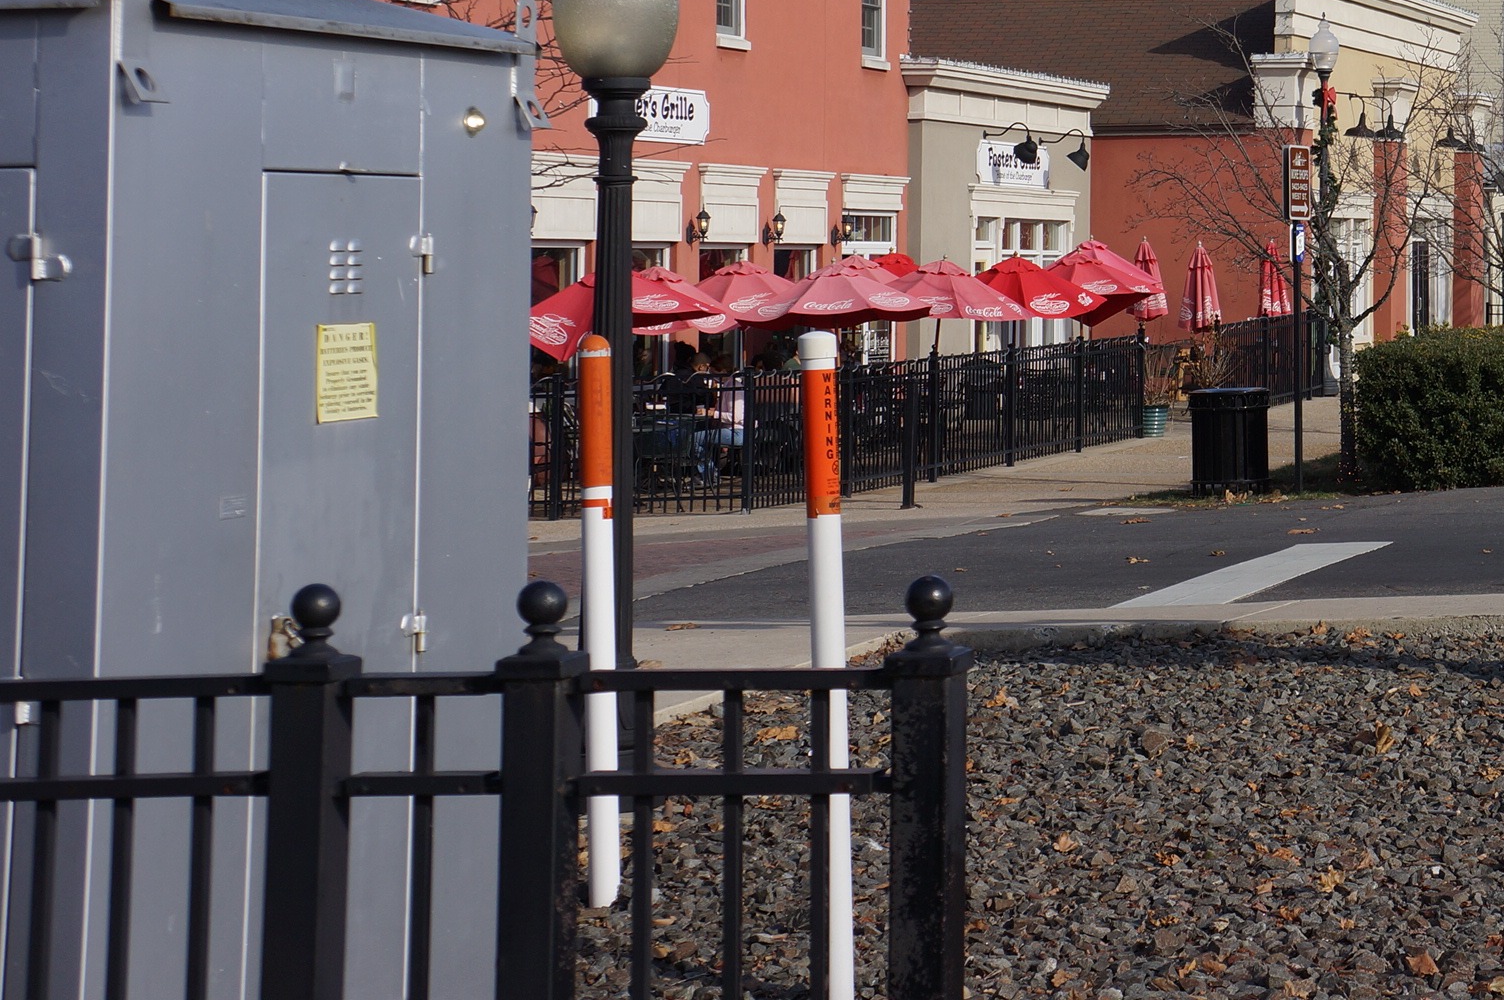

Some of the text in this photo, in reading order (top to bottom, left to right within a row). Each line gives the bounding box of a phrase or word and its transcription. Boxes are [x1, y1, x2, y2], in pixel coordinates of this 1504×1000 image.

[636, 93, 694, 121] er's Grille
[988, 147, 1018, 169] Foster's
[822, 372, 834, 460] WARNING
